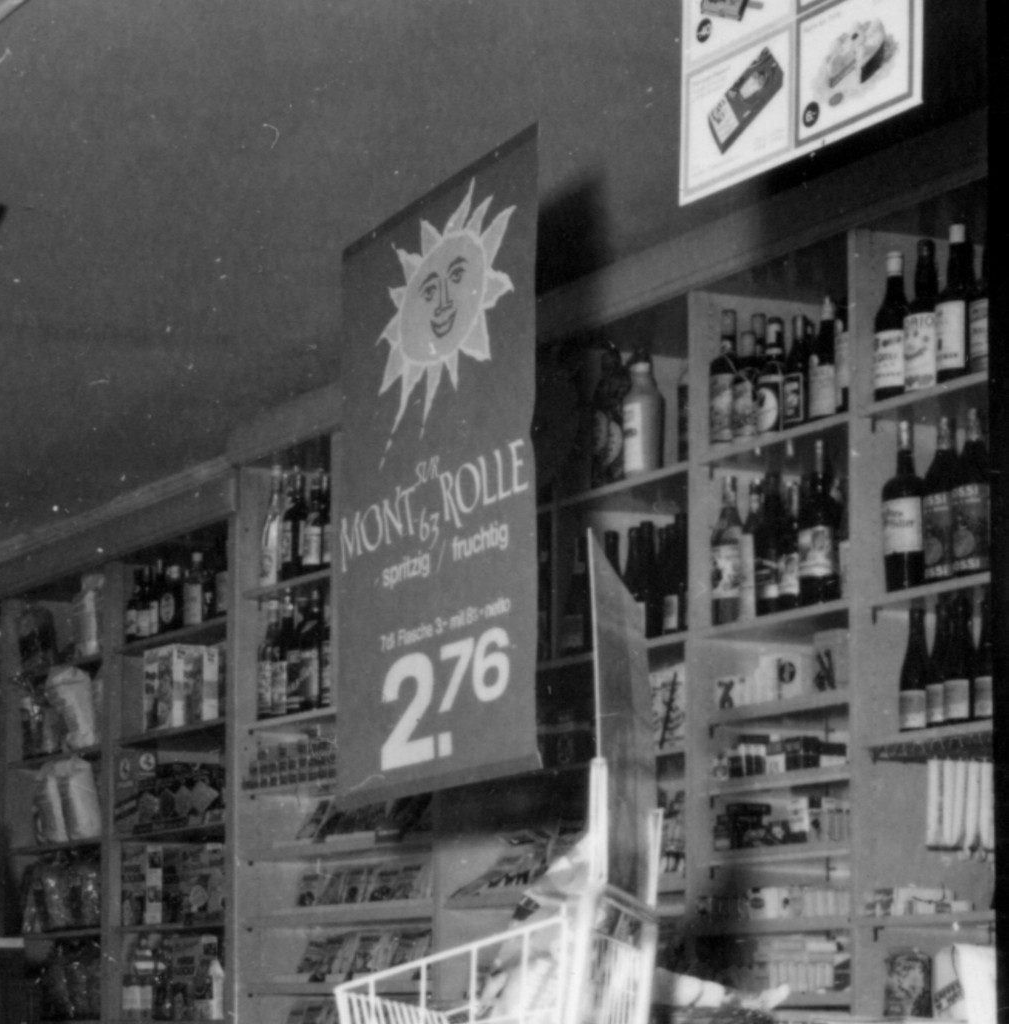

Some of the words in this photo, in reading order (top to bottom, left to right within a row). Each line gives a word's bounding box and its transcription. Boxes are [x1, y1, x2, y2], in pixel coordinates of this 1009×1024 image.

[415, 456, 441, 486] SUR
[341, 485, 415, 573] MONT
[439, 438, 530, 529] ROLLE
[452, 520, 509, 562] fruchtig
[382, 551, 430, 590] spritzig
[380, 627, 511, 772] 2.76
